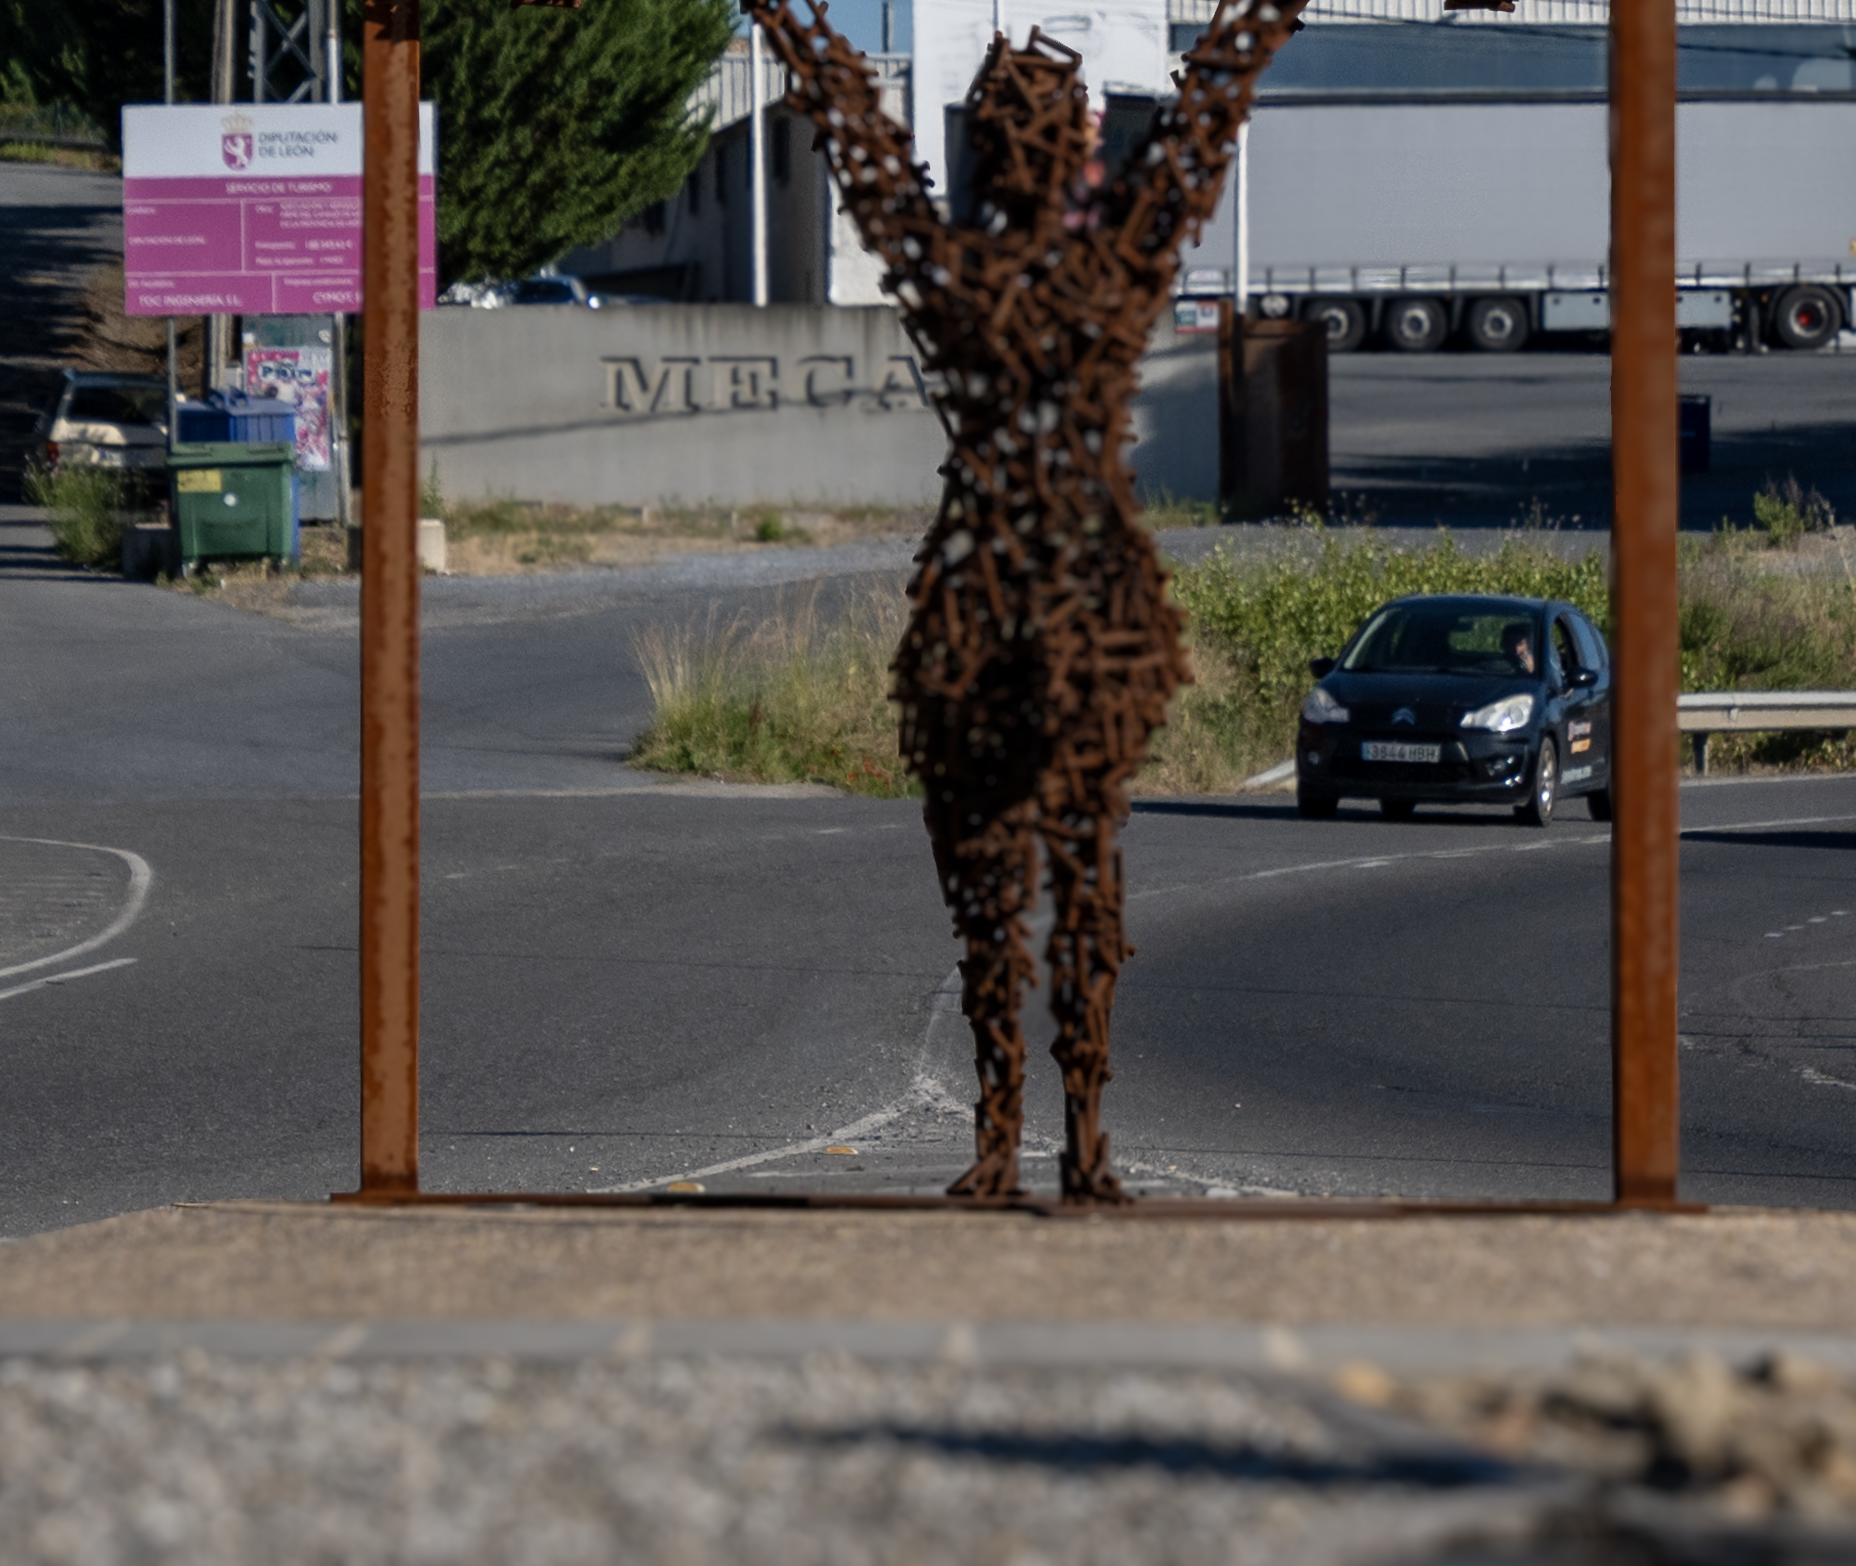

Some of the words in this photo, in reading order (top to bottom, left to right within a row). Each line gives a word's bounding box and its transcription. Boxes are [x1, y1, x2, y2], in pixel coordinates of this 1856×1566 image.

[259, 131, 337, 144] DIPUTACIÓN
[258, 146, 278, 158] DE
[279, 144, 314, 158] LEÓN
